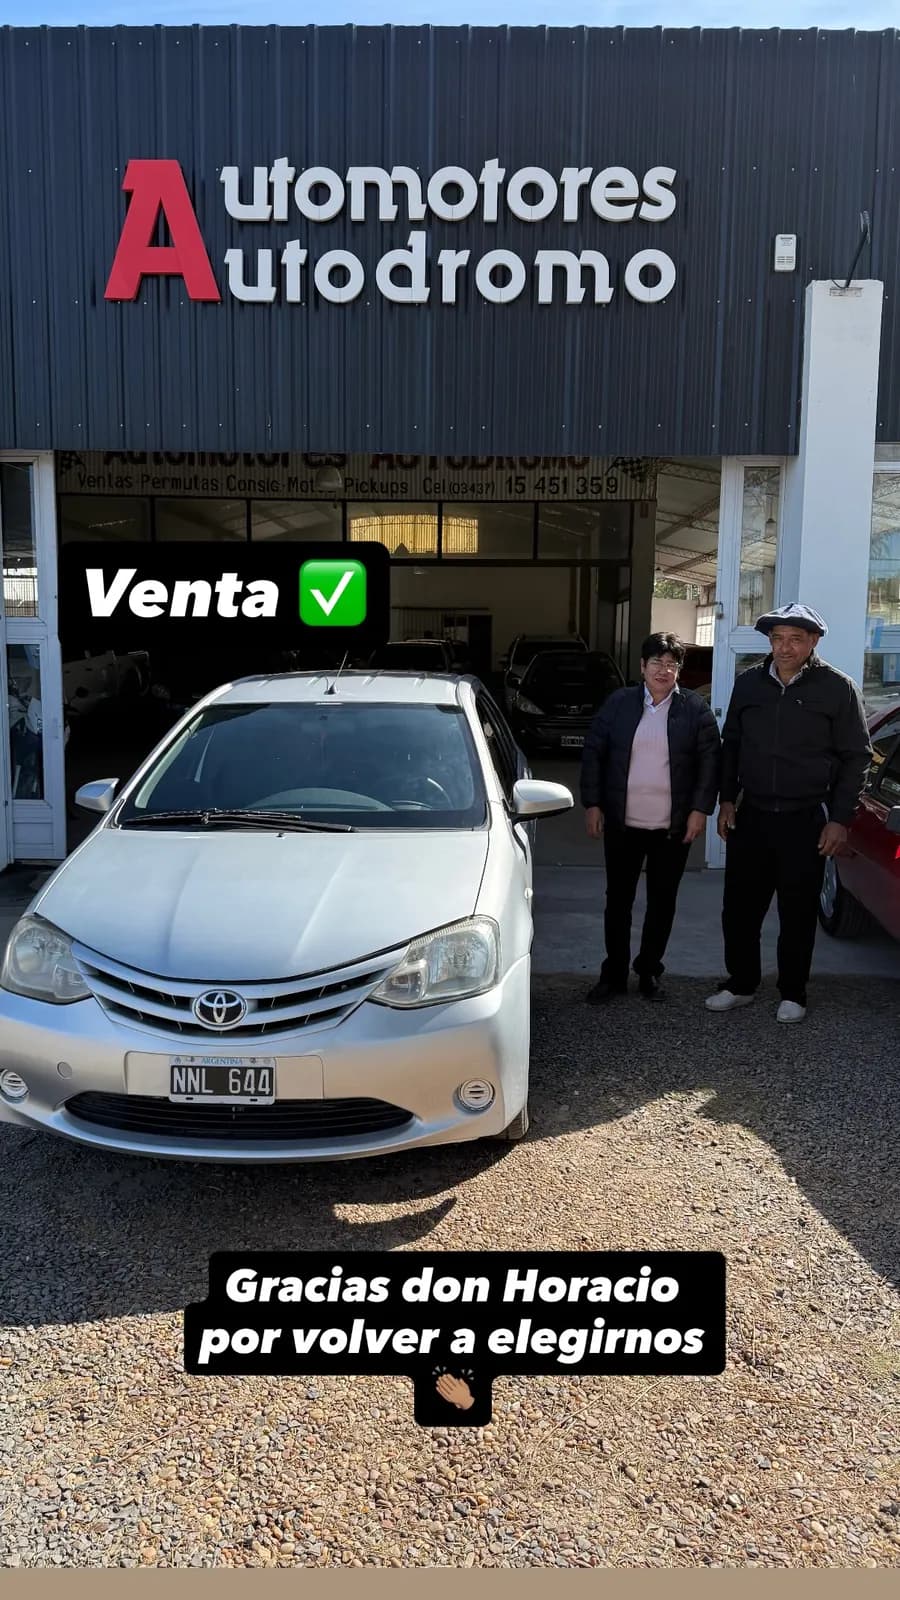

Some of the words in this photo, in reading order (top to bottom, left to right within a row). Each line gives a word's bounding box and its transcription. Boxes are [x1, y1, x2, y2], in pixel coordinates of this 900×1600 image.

[78, 473, 133, 489] Ventas
[141, 474, 219, 491] Permutas
[288, 476, 337, 494] Mot
[344, 477, 409, 496] Pickups
[423, 477, 446, 494] Cel
[506, 475, 526, 494] 15
[201, 1057, 243, 1065] ARGENTINA
[173, 1067, 213, 1093] NNL
[229, 1068, 270, 1094] 644
